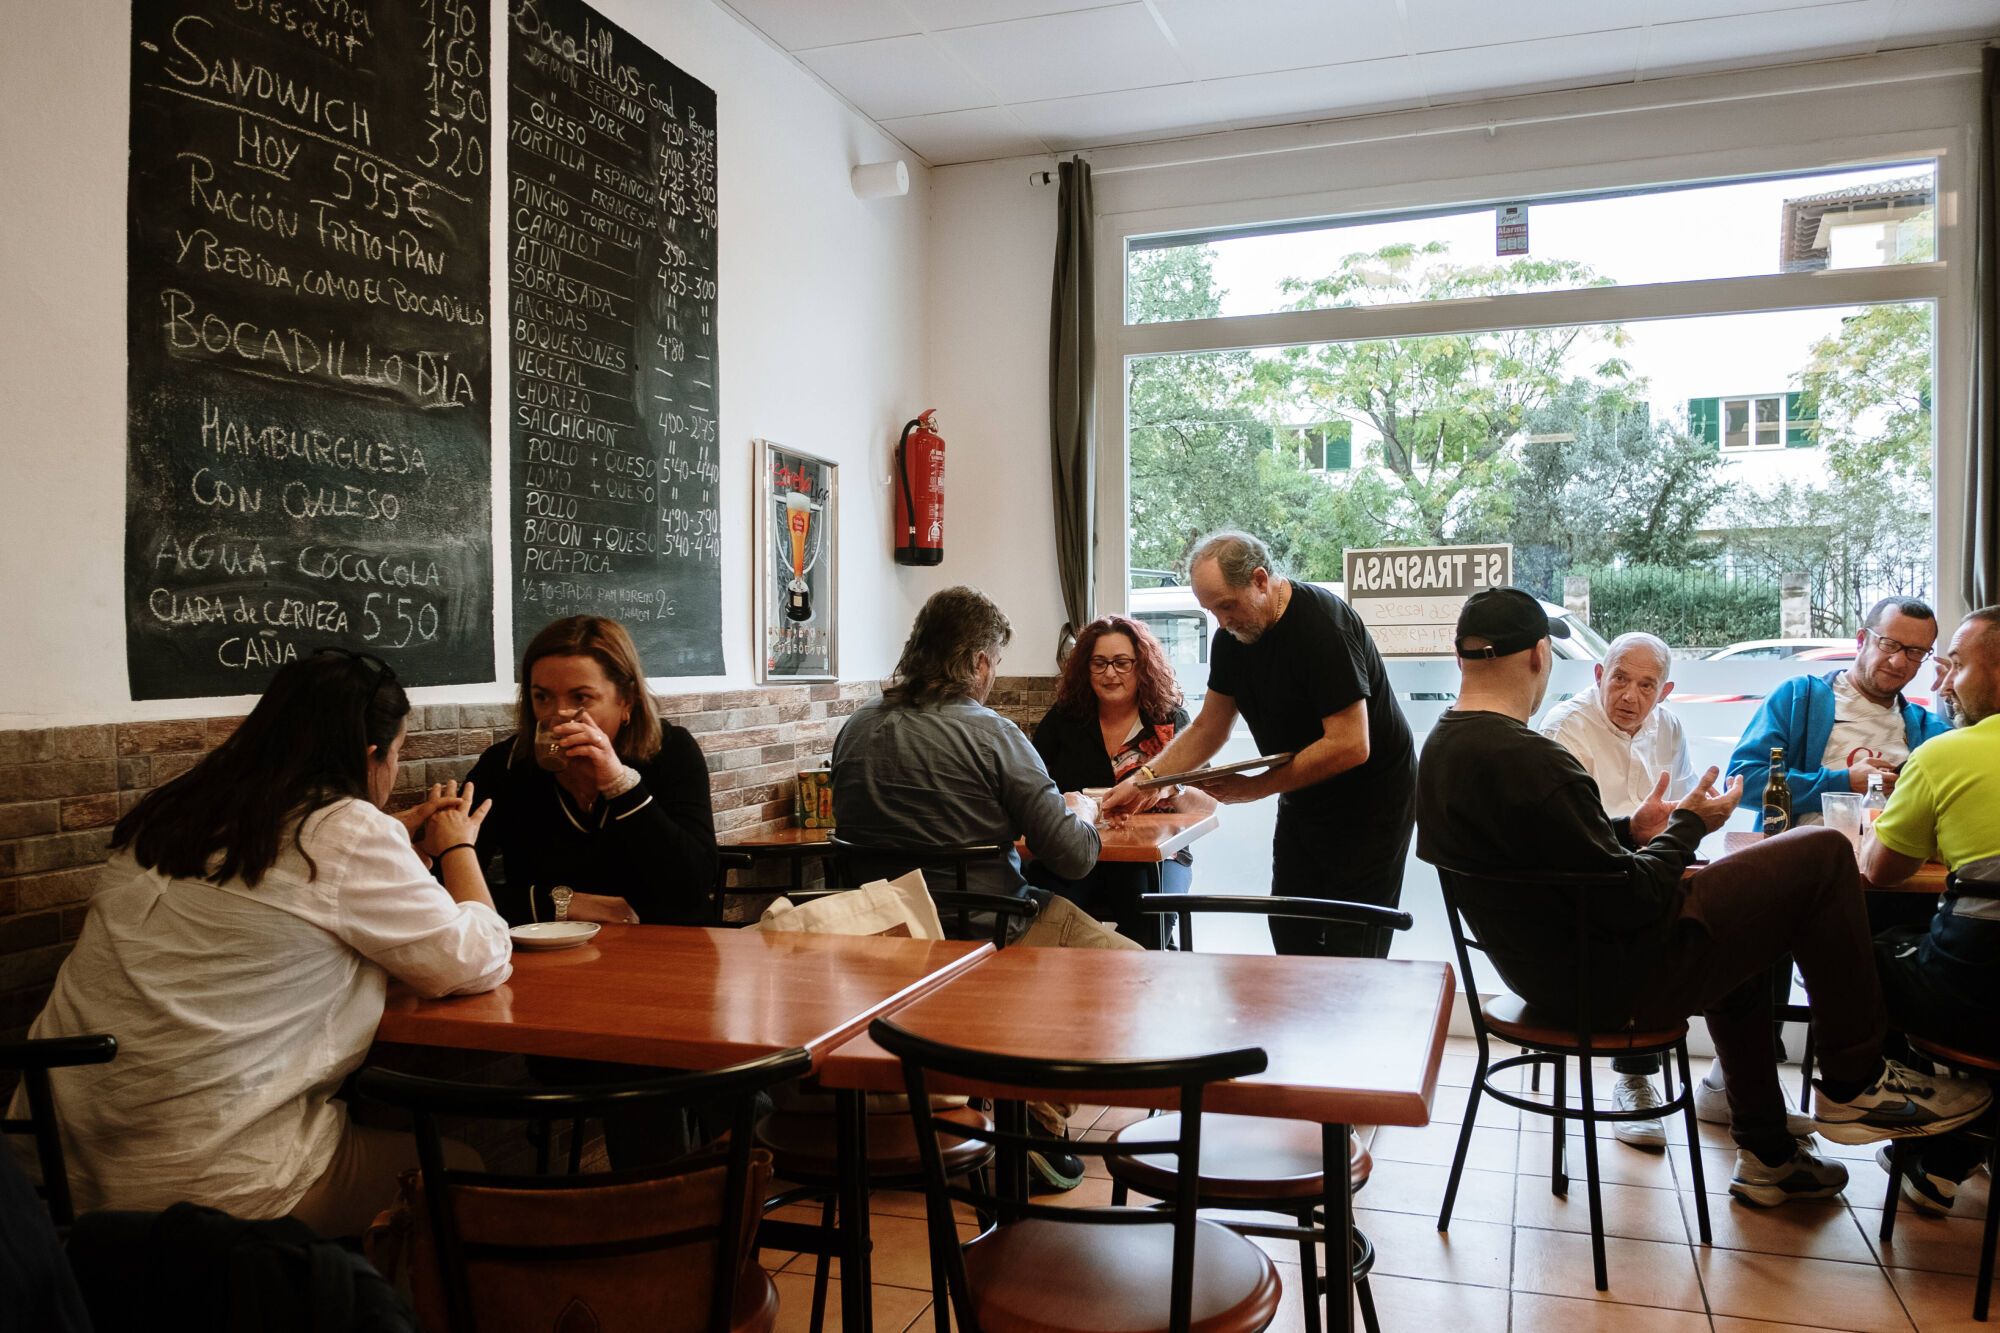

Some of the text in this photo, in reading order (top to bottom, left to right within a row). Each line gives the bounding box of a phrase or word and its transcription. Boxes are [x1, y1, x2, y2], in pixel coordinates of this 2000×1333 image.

[423, 28, 483, 77] 1'60
[424, 72, 487, 124] 1'50
[587, 79, 645, 124] SERRANO
[238, 115, 300, 173] HOY
[530, 102, 587, 145] QUESO
[588, 106, 626, 141] YORK
[417, 120, 485, 177] 3'20
[510, 120, 585, 172] TORTILLA
[513, 178, 569, 217] PINCHO
[580, 210, 642, 249] TORTILLA
[515, 207, 603, 256] CAMAIOT
[515, 235, 562, 271] ATUN
[511, 263, 617, 317] SOBRASADA
[514, 292, 588, 332] ANCHOAS
[514, 318, 626, 370] BOQUERONES
[517, 349, 586, 387] VEGETAL
[515, 377, 591, 414] CHORIZO
[201, 397, 428, 475] HAMBURGUESA
[517, 406, 618, 447] SALCHICHON
[528, 438, 578, 466] POLLO
[605, 451, 657, 479] QUESO
[192, 468, 400, 520] CON QUESO
[526, 465, 571, 492] LOMO
[606, 478, 656, 503] QUESO
[526, 491, 578, 520] POLLO
[524, 519, 582, 547] BACON
[605, 527, 657, 553] QUESO
[523, 548, 614, 573] PICA-PICA
[539, 582, 593, 601] TOSTADA
[149, 588, 226, 625] CLARA
[263, 598, 349, 633] CERVEZA
[362, 592, 439, 649] 5'50
[218, 630, 298, 669] CAÑA
